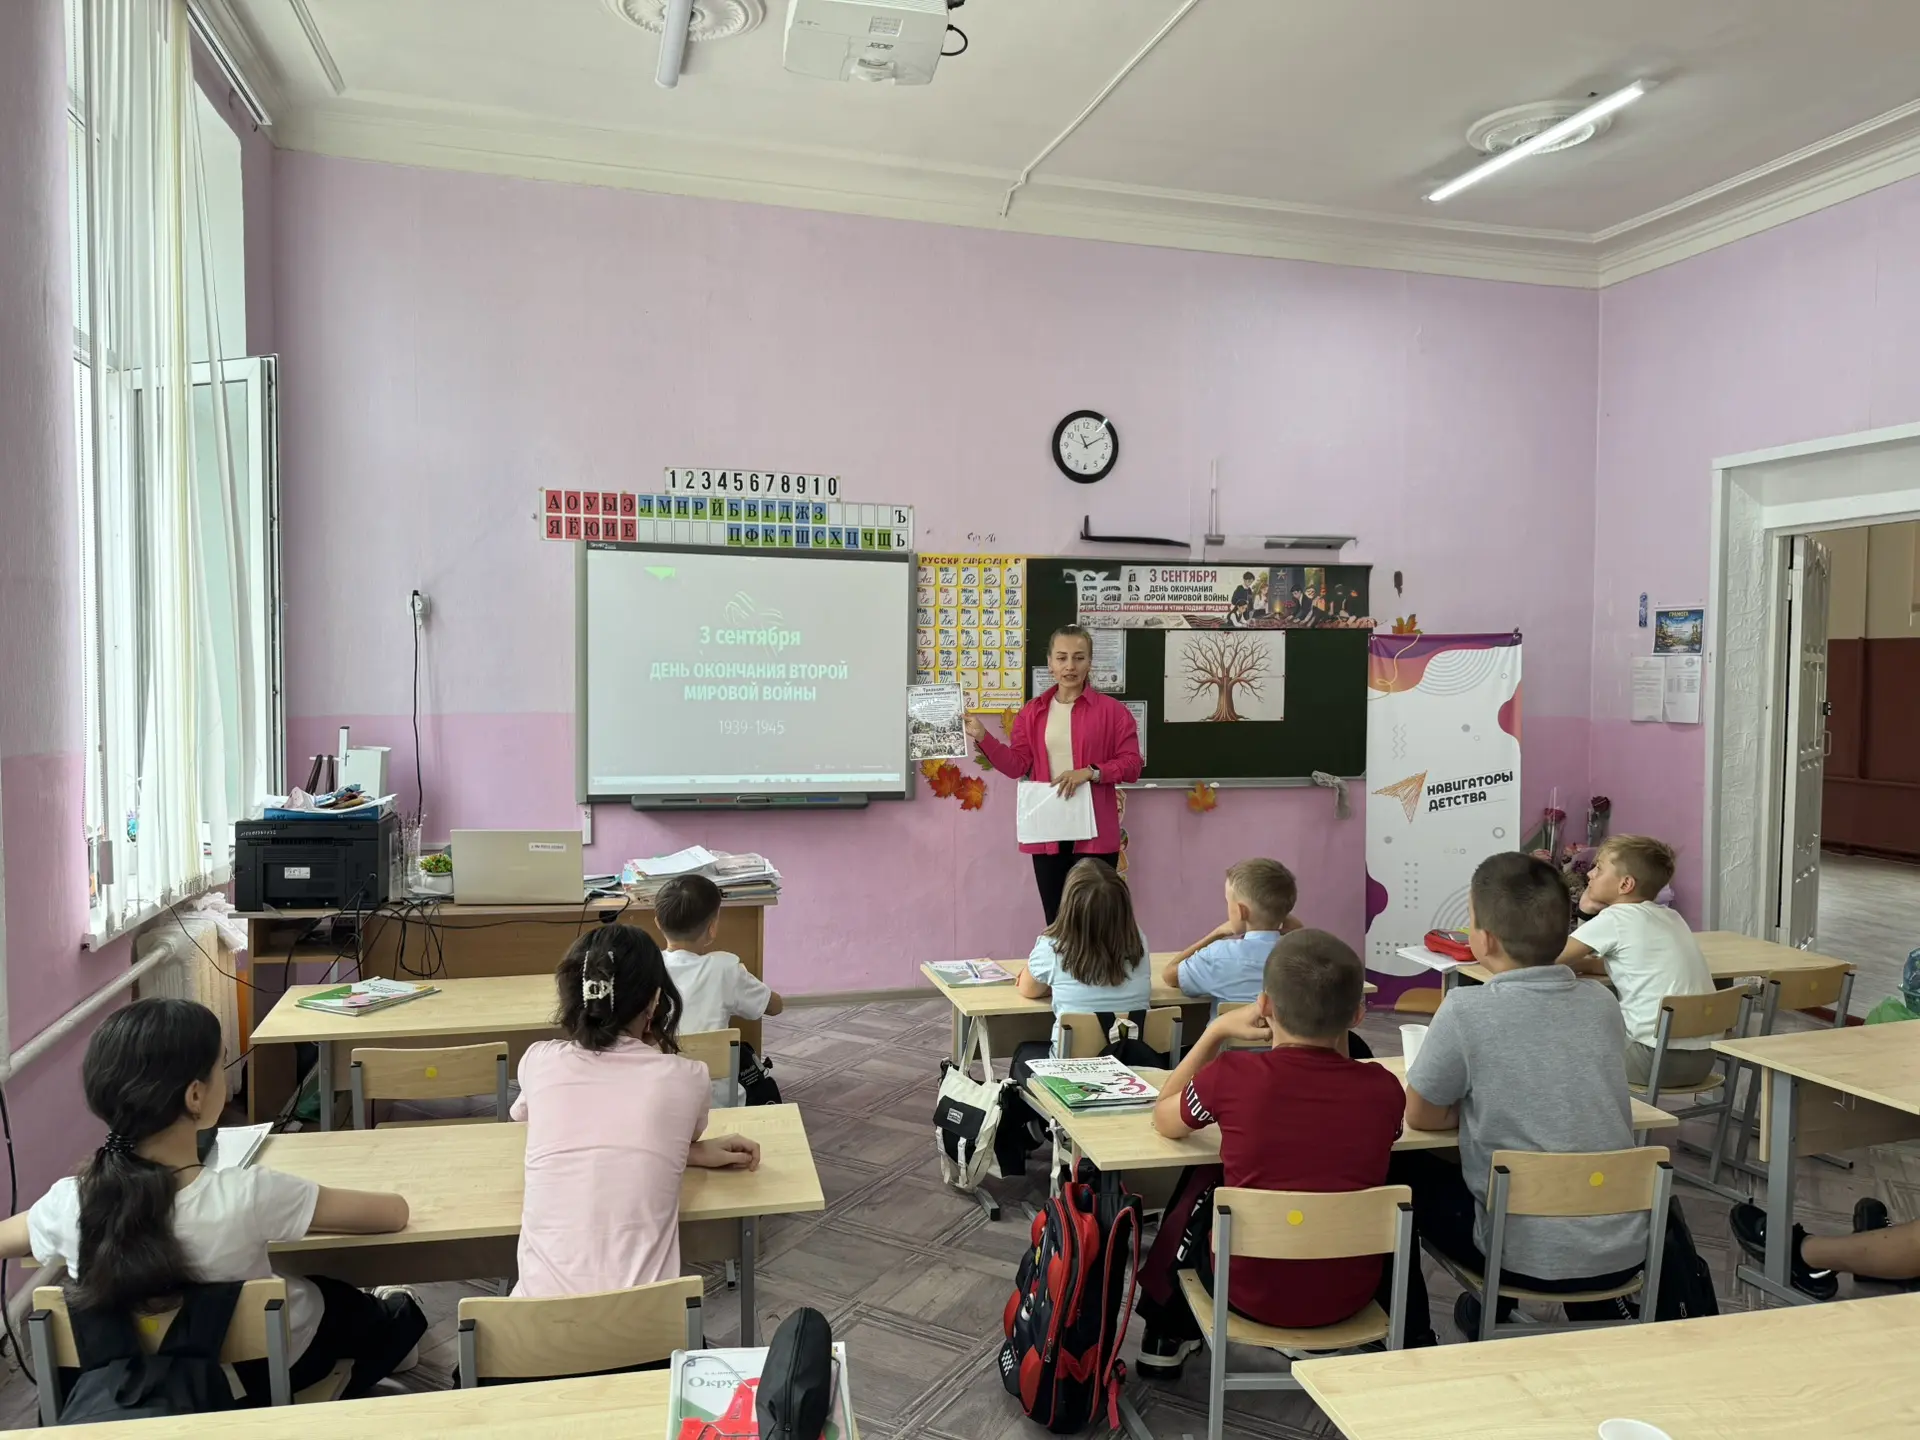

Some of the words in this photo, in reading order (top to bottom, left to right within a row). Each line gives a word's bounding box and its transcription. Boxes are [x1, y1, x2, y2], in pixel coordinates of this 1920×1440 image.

[670, 470, 676, 488] 1
[686, 470, 695, 489] 2
[702, 471, 711, 490] 3
[718, 472, 727, 490] 4
[734, 473, 743, 491] 5
[750, 473, 759, 492] 6
[765, 474, 774, 492] 7
[781, 475, 790, 493] 8
[797, 475, 806, 494] 9
[548, 495, 560, 509] А
[567, 495, 578, 510] О
[586, 496, 597, 511] У
[602, 497, 617, 512] Ы
[624, 499, 633, 512] Э
[640, 499, 652, 512] Л
[659, 500, 671, 513] М
[677, 501, 688, 514] Н
[694, 502, 704, 515] Р
[712, 499, 723, 516] Й
[729, 503, 738, 516] Б
[748, 504, 757, 517] В
[764, 504, 773, 518] Г
[780, 505, 791, 522] Д
[796, 506, 810, 520] Ж
[815, 507, 823, 520] З
[895, 510, 906, 524] Ъ
[549, 520, 560, 534] Я
[569, 518, 578, 534] Ё
[584, 522, 599, 535] Ю
[604, 522, 615, 536] И
[624, 523, 634, 537] Е
[729, 528, 740, 541] П
[746, 528, 758, 541] Ф
[764, 529, 774, 542] К
[781, 529, 792, 543] Т
[796, 530, 810, 544] Ш
[815, 531, 824, 544] С
[830, 531, 841, 545] Х
[847, 532, 858, 548] Ц
[864, 532, 873, 546] Ч
[878, 533, 891, 548] Щ
[896, 534, 905, 547] Ь
[1150, 569, 1157, 582] 3
[1161, 570, 1217, 582] СЕНТЯБРЯ
[1150, 585, 1168, 593] ДЕНЬ
[1168, 593, 1201, 601] МИРОВОЙ
[1204, 593, 1229, 602] ВОЙНЫ
[700, 626, 710, 644] 3
[715, 626, 800, 651] сентября
[650, 662, 689, 681] ДЕНЬ
[693, 663, 785, 679] ОКОНЧАНИЯ
[790, 660, 848, 679] ВТОРОЙ
[684, 682, 758, 701] МИРОВОЙ
[763, 682, 816, 701] ВОЙНЫ
[719, 720, 785, 735] 1939-1945
[1427, 771, 1513, 796] НАВИГАТОРЫ
[1429, 791, 1487, 812] ДЕТСТВА
[1115, 1077, 1147, 1094] 3
